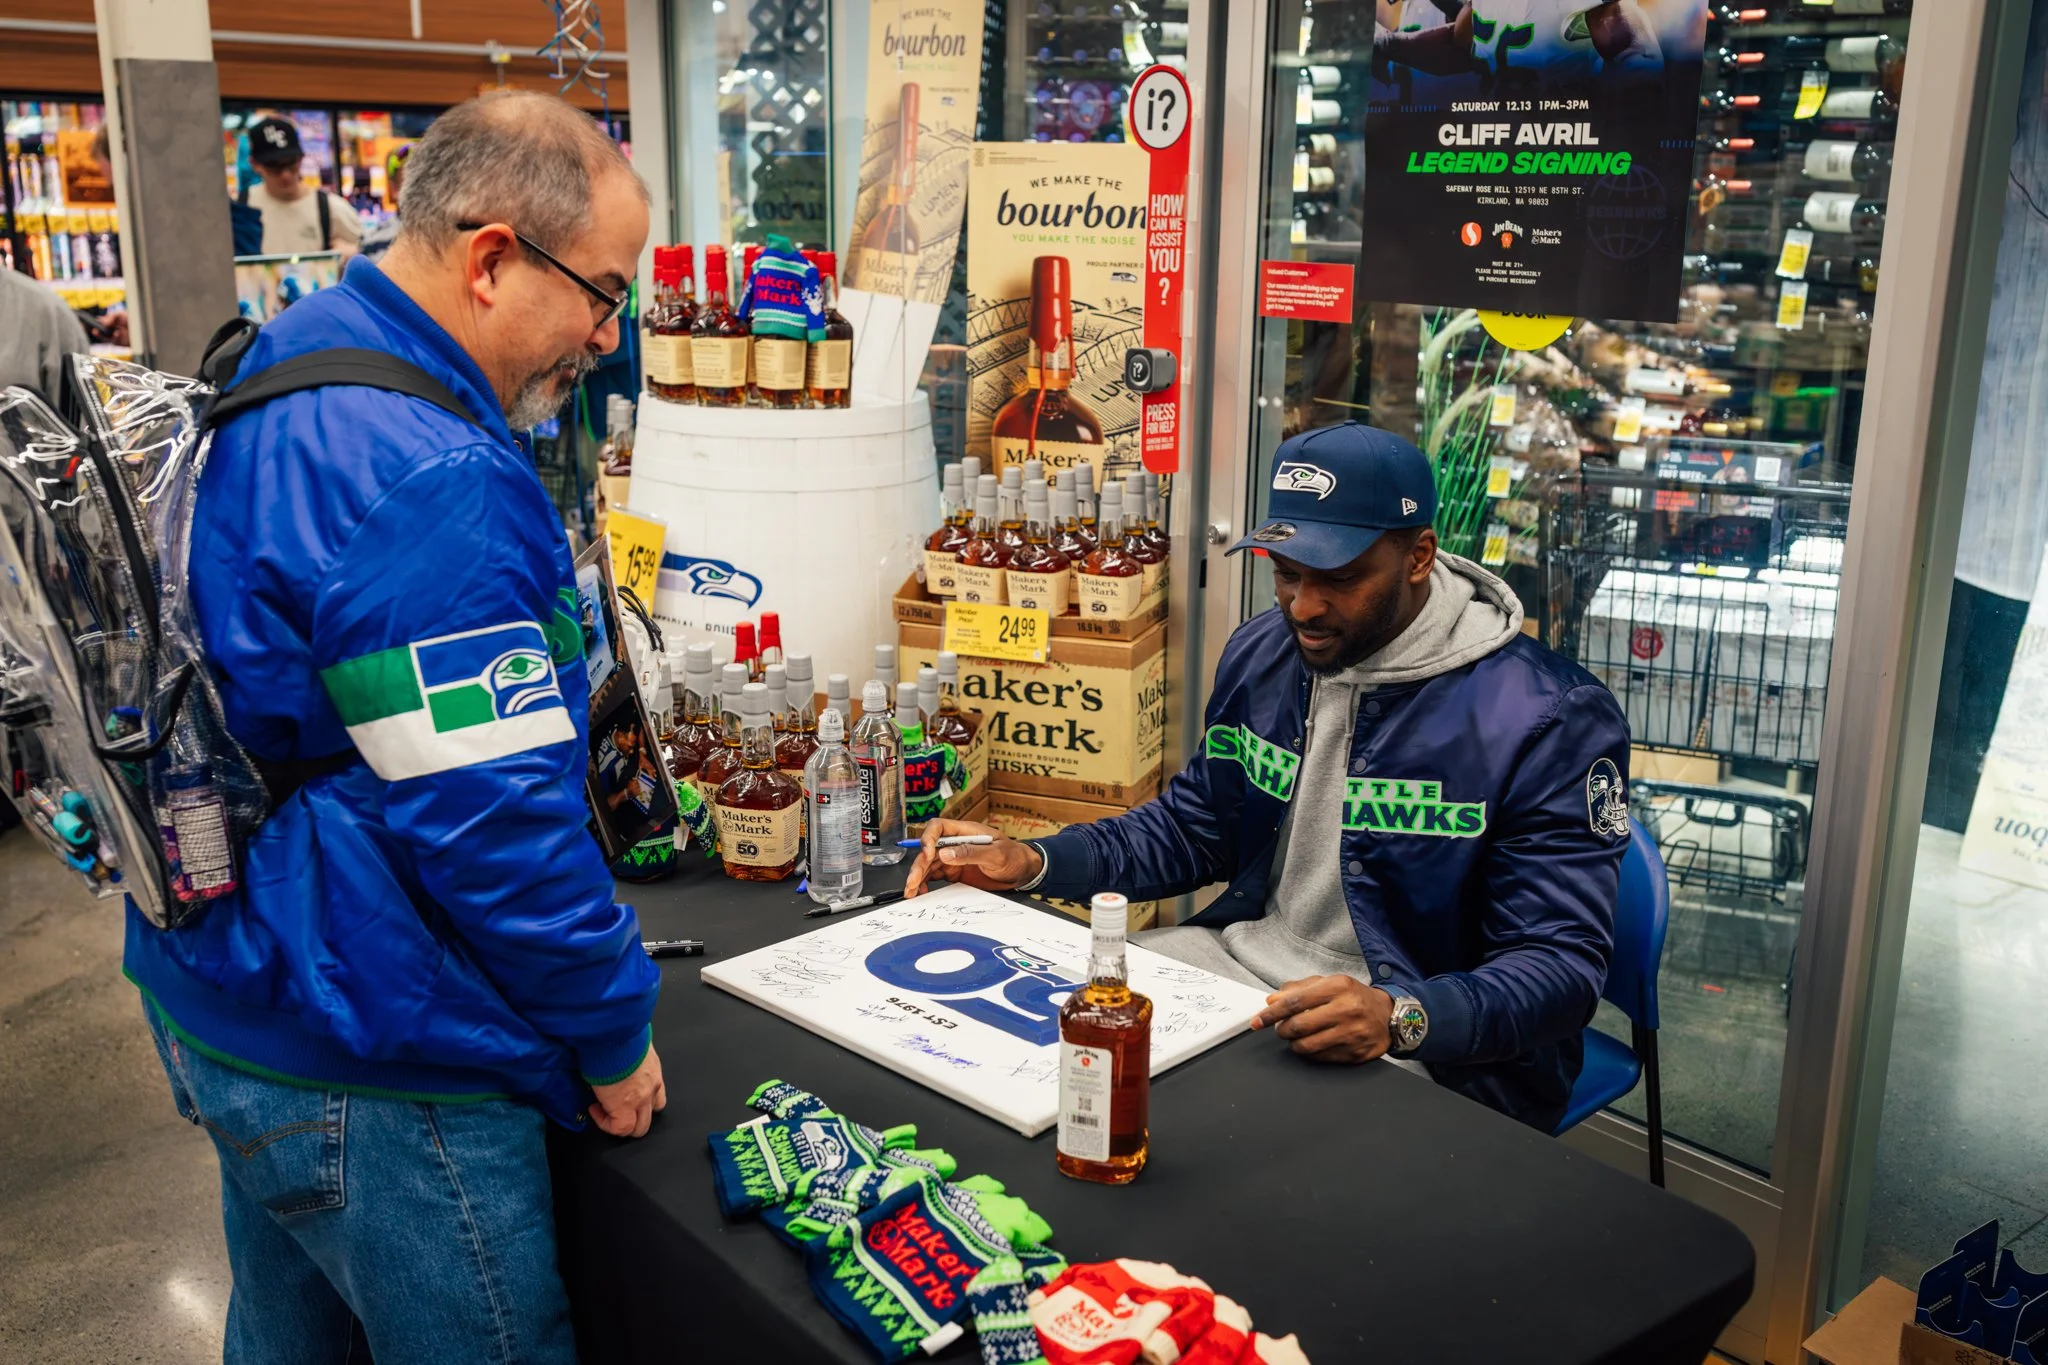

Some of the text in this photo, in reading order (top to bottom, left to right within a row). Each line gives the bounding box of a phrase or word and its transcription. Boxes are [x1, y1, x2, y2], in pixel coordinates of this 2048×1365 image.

[884, 22, 965, 57] bourbon
[1451, 101, 1500, 112] SATURDAY
[1506, 101, 1531, 111] 12.13
[1438, 123, 1599, 146] CLIFF AVRIL
[1406, 151, 1632, 175] LEGEND SIGNING
[1029, 176, 1123, 191] WE MAKE THE
[1446, 185, 1473, 193] SAFEWAY
[1476, 185, 1492, 193] ROSE
[1494, 186, 1510, 194] HILL
[1514, 186, 1536, 194] 12519
[1151, 195, 1184, 216] HOW
[1477, 197, 1549, 206] KIRKLAND, WA 98033
[997, 188, 1146, 230] bourbon
[1150, 218, 1183, 231] CAN WE
[1492, 220, 1524, 238] JIM BEAM
[1532, 228, 1562, 237] Maker's
[1012, 233, 1137, 246] YOU MAKE THE NOISE
[1149, 233, 1182, 246] ASSIST
[1539, 236, 1561, 245] Mark
[1149, 249, 1180, 272] YOU
[1509, 269, 1541, 277] RESPONSIBLY
[1510, 277, 1536, 285] NECESSARY
[758, 290, 802, 306] Mark
[1091, 374, 1126, 403] LUM
[1146, 403, 1175, 422] PRESS
[1146, 421, 1175, 434] FOR HELP
[929, 554, 955, 562] Make
[939, 578, 955, 588] 50
[965, 577, 990, 587] Mark
[1010, 575, 1047, 584] Maker's
[1081, 577, 1119, 587] Maker's
[1020, 584, 1047, 593] Mark
[1091, 587, 1118, 597] Mark
[966, 592, 980, 602] 50
[1021, 600, 1036, 608] 50
[1092, 603, 1107, 613] 50
[990, 750, 1079, 765] STRAIGHT BOURBON
[905, 760, 938, 776] er's
[988, 758, 1056, 777] HISKY
[905, 777, 936, 792] ark
[1082, 784, 1106, 798] 16.9 kg
[860, 769, 870, 824] essentia
[721, 810, 772, 824] Maker's
[735, 823, 773, 835] Mark
[738, 844, 758, 856] 50
[886, 997, 925, 1015] 1976
[922, 1014, 958, 1030] EST
[791, 1131, 815, 1167] SEATTLE
[896, 1202, 980, 1292] Maker'
[885, 1237, 957, 1309] Mark
